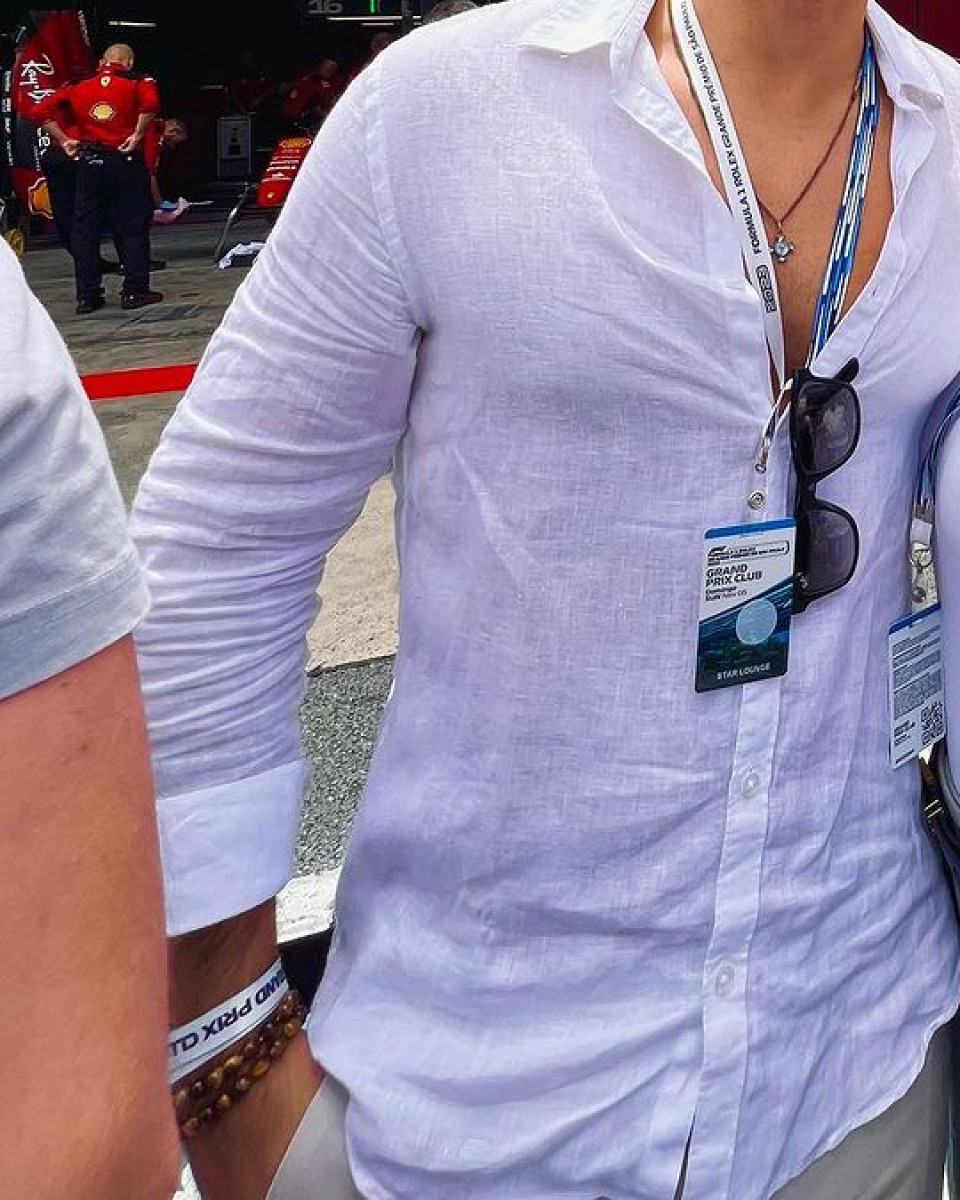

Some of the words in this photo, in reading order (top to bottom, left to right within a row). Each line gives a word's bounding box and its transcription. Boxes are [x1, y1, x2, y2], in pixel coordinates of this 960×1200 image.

[712, 103, 732, 148] GRANDE
[727, 150, 743, 187] ROLEX
[739, 196, 761, 254] FORMULA
[705, 563, 748, 578] GRAND
[705, 574, 732, 587] PRIX
[733, 570, 763, 583] CLUB
[716, 668, 738, 680] STAR
[202, 998, 252, 1041] PRIX
